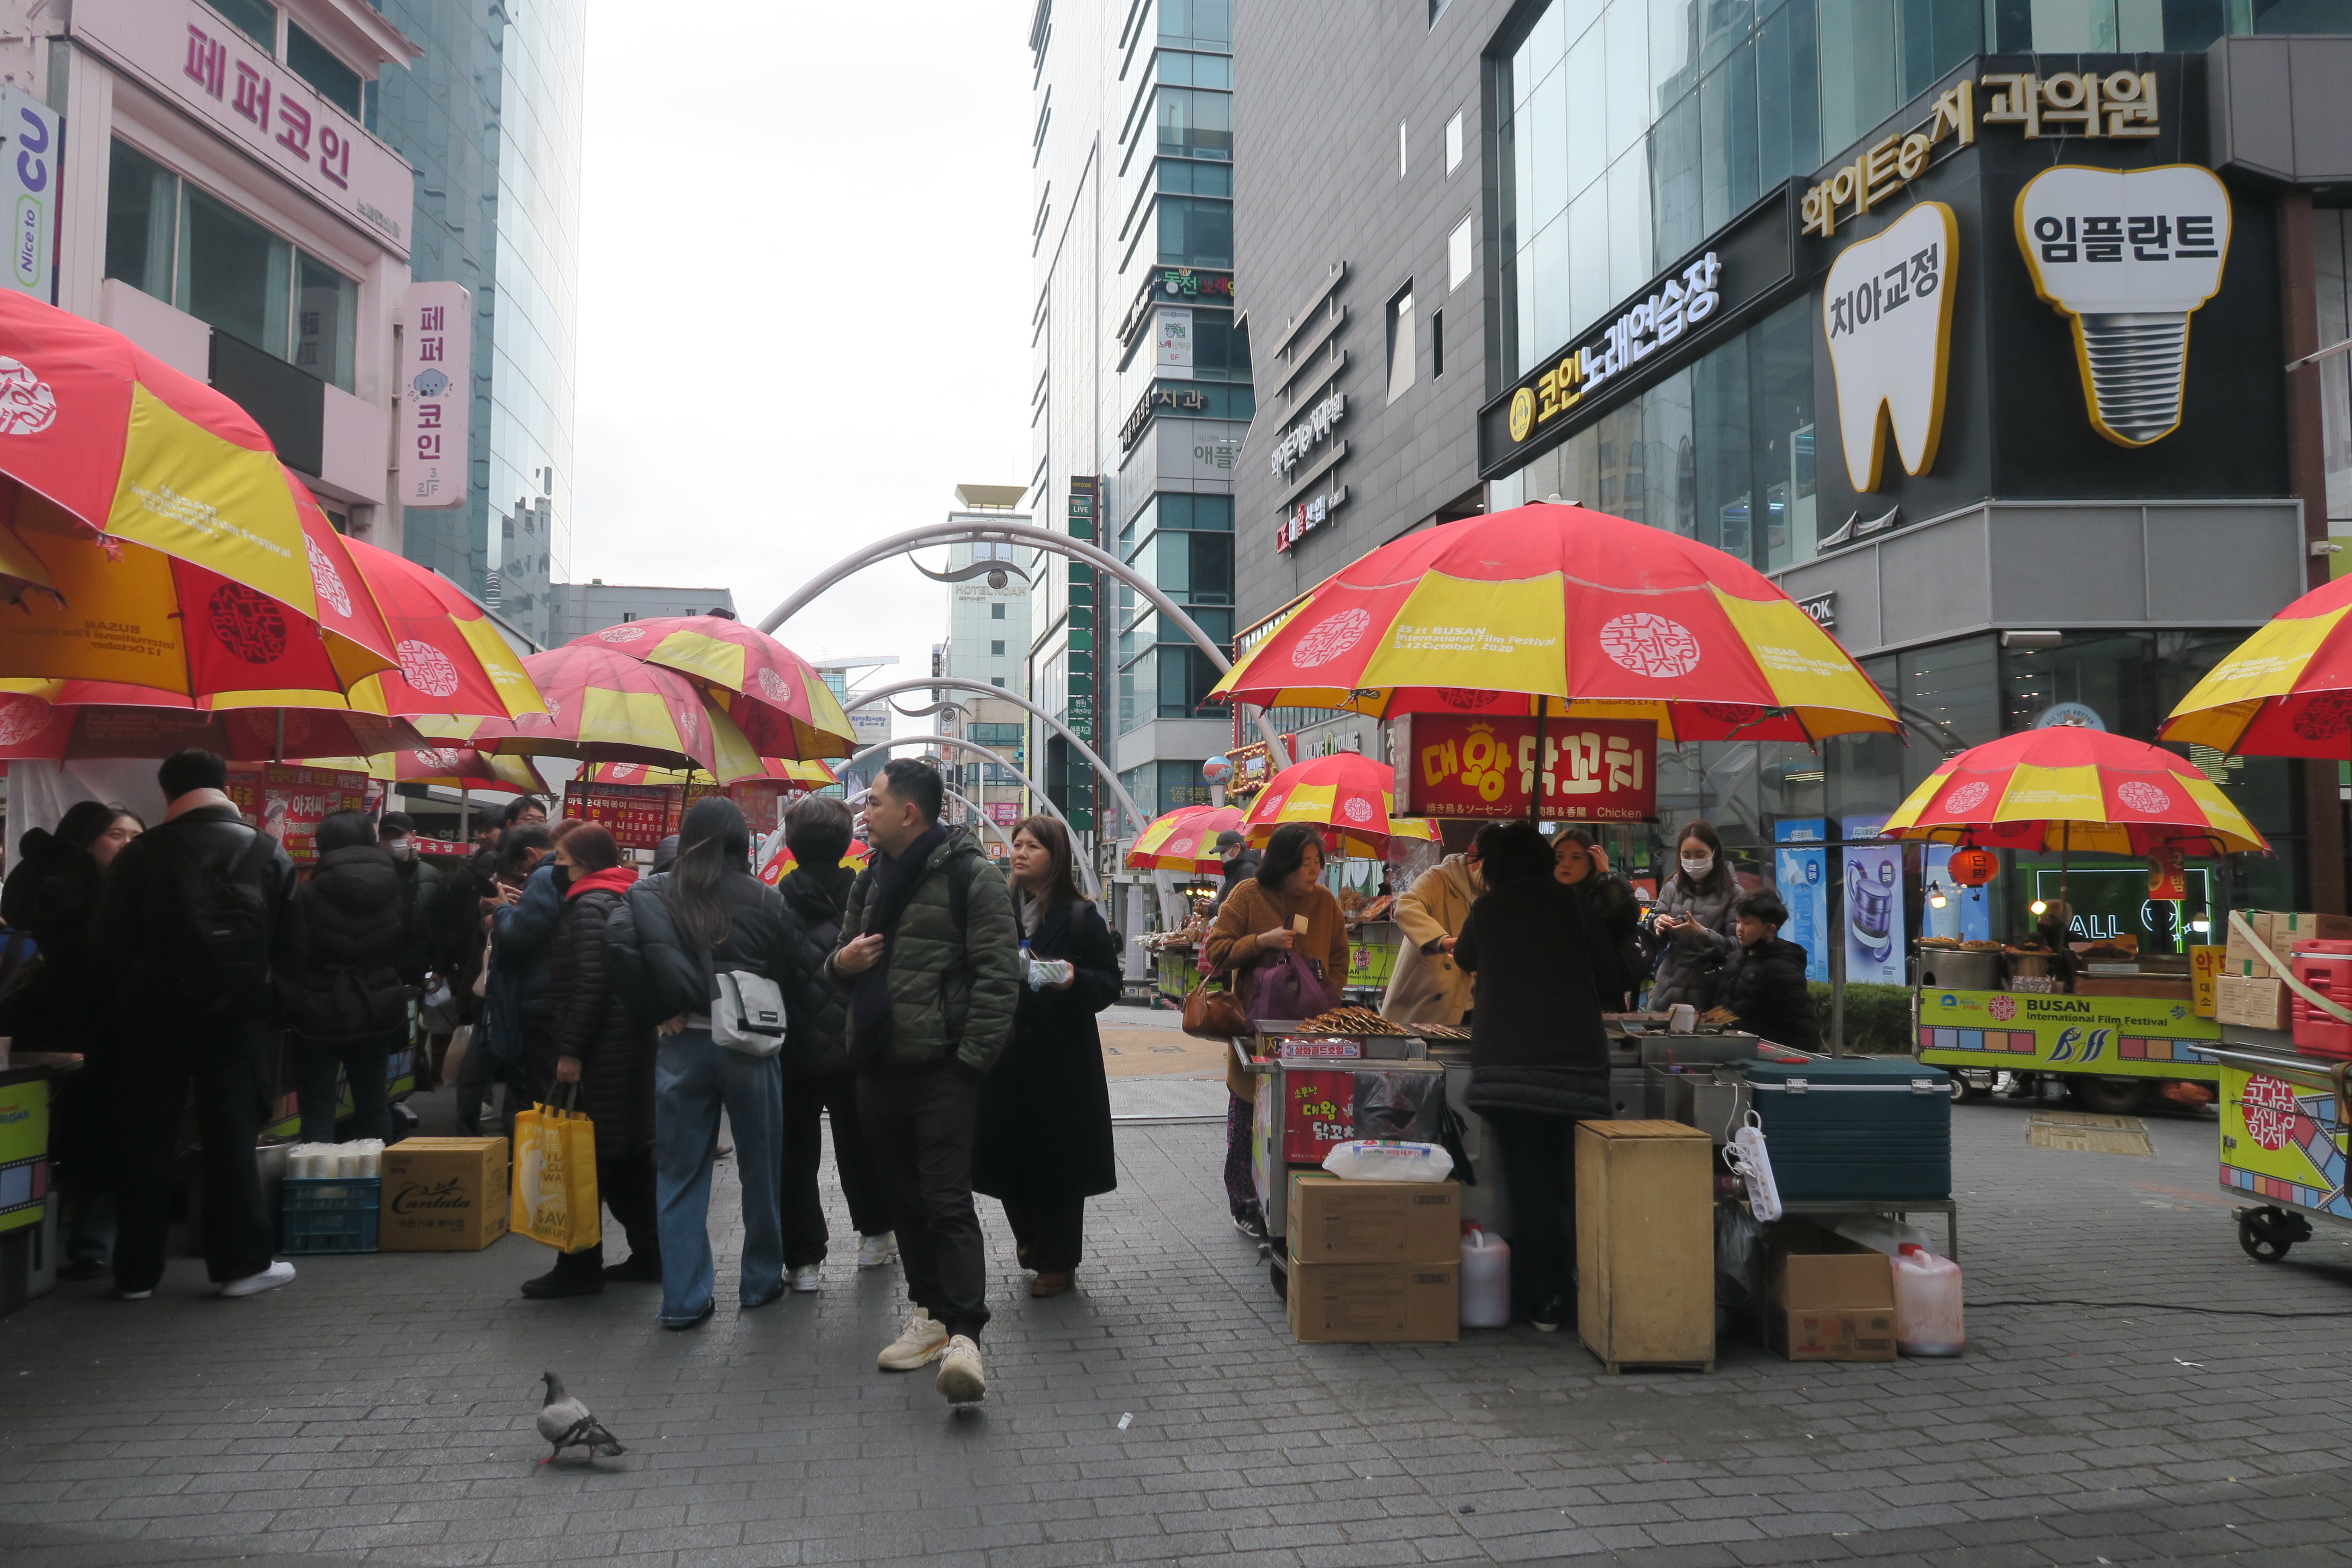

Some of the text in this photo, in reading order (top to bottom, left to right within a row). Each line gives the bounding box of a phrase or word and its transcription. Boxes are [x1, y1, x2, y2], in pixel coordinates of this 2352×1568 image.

[183, 22, 350, 191] 페퍼코인
[1802, 71, 2160, 236] 화이트e치과의원
[17, 107, 49, 272] Nice to CU
[2035, 216, 2218, 263] 임플란트
[1162, 271, 1197, 295] 동전
[1830, 241, 1940, 340] 치아교정
[1164, 323, 1186, 339] 동전
[1538, 252, 1722, 423] 코인노래연습장
[1158, 388, 1204, 409] 치과
[955, 585, 1027, 596] HOTEL NOAH
[1395, 632, 1555, 646] International Film Festival
[1397, 625, 1487, 635] 25 st BUSAN
[1393, 641, 1515, 653] 3-12 October, 2020
[851, 715, 886, 727] 자갈치시장
[2045, 709, 2094, 726] ALL LIVE BETTER
[1305, 731, 1359, 760] OLIVE YOUNG
[1422, 731, 1512, 803] 대왕
[1518, 731, 1643, 797] 닭꼬치
[292, 793, 326, 817] 아저씨
[1426, 803, 1455, 814] 焼き鳥
[1466, 805, 1513, 814] ソーセージ
[1597, 807, 1643, 818] Chicken
[1972, 855, 1987, 879] 단밤
[2068, 914, 2124, 939] ALL
[2200, 983, 2211, 993] 대
[2026, 999, 2090, 1013] BUSAN
[2200, 997, 2212, 1007] 소
[2026, 1012, 2168, 1027] International Film Festival
[1294, 1046, 1344, 1055] 삼화골드호일
[1294, 1085, 1318, 1099] 소문난
[1302, 1100, 1338, 1120] 대왕
[391, 1181, 471, 1215] Cantata
[536, 1209, 566, 1227] SAV
